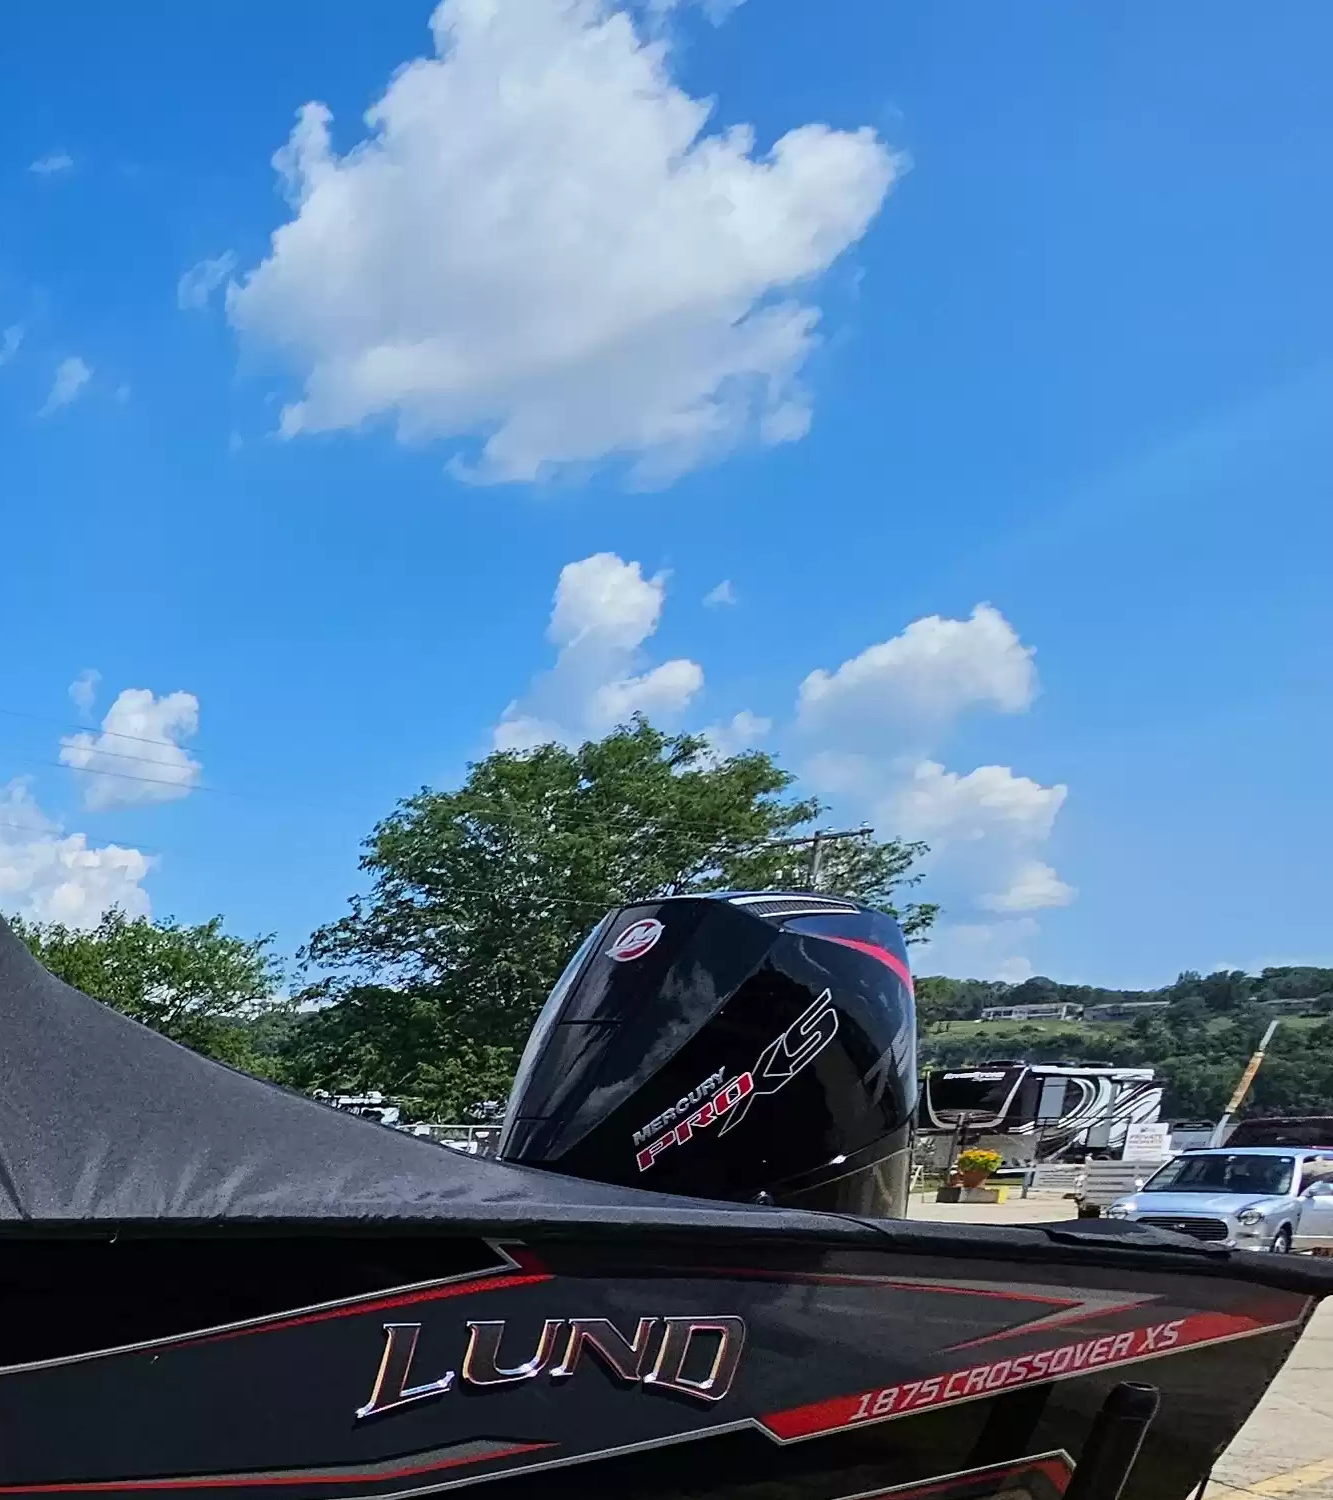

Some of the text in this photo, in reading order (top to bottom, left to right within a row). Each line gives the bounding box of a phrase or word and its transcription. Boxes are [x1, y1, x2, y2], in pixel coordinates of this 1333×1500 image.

[632, 1066, 725, 1146] MERCURY
[636, 988, 838, 1172] PRO XS
[356, 1315, 746, 1418] LUND
[849, 1320, 1185, 1421] 1875 CROSSOVER XS
